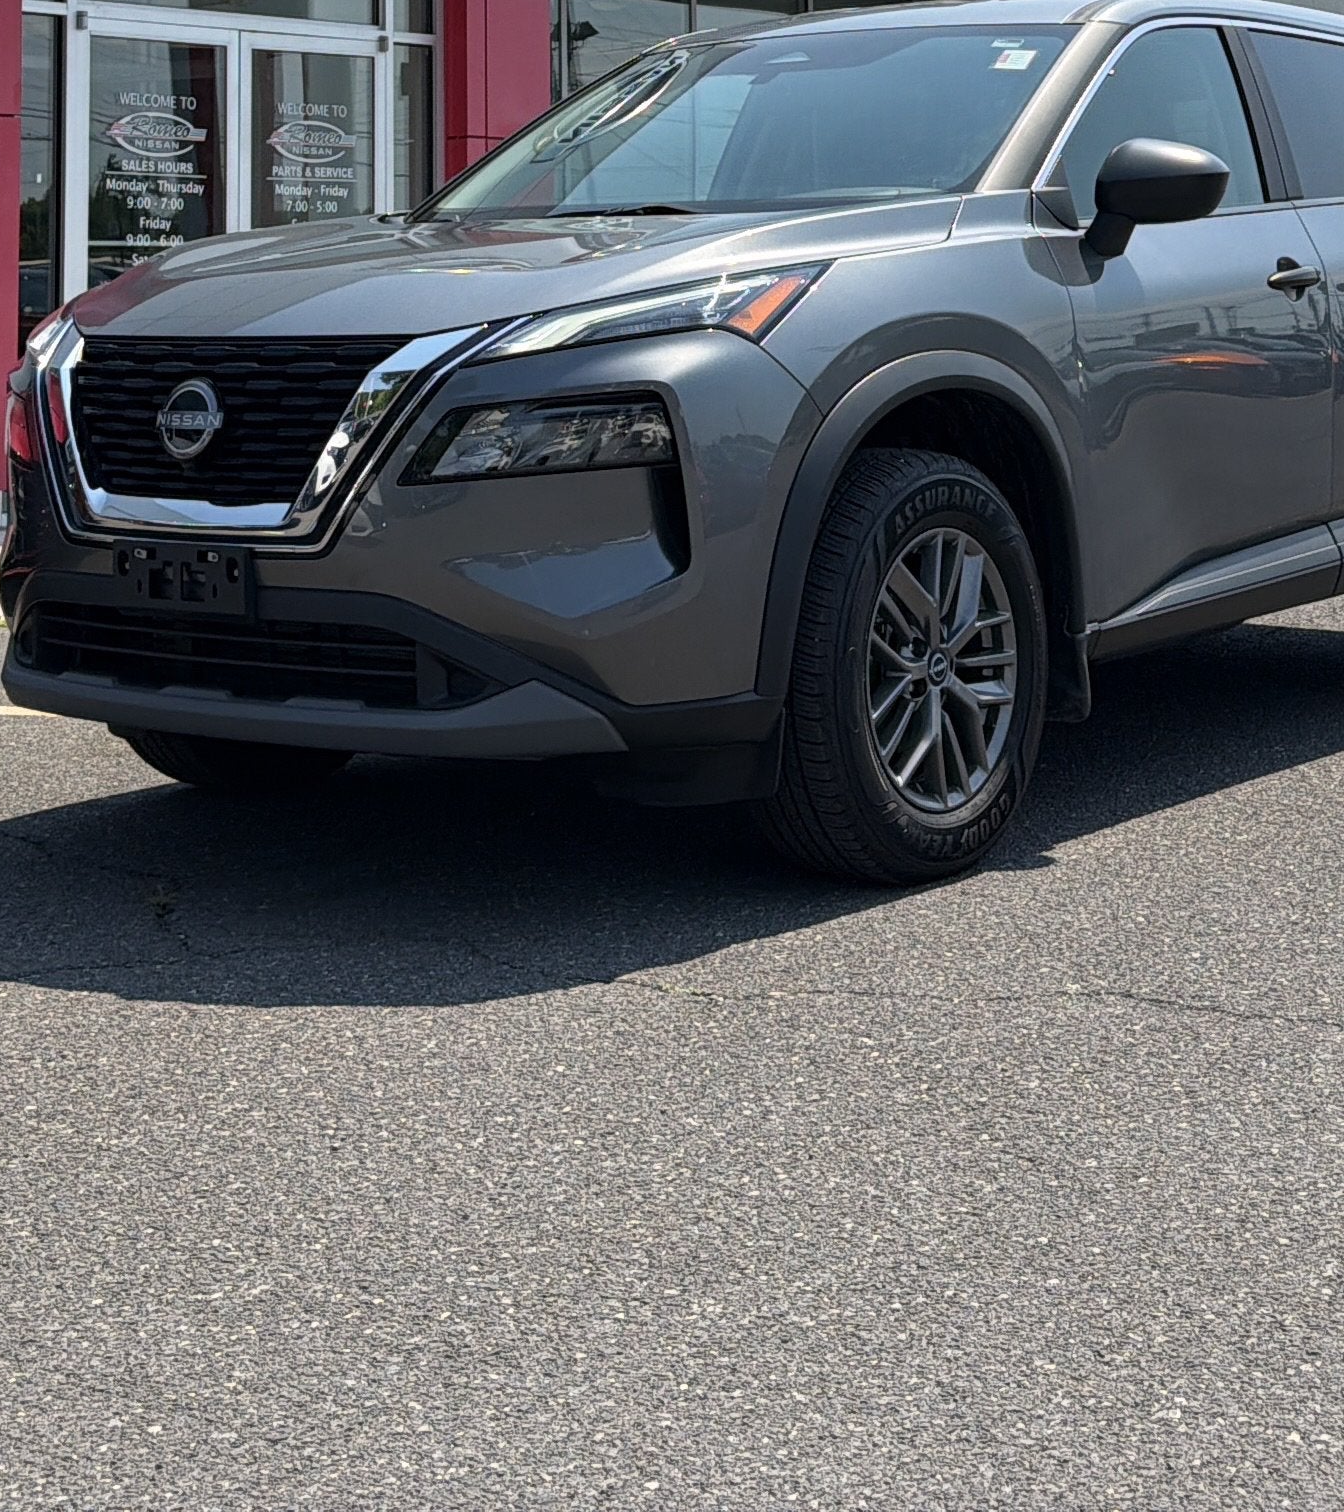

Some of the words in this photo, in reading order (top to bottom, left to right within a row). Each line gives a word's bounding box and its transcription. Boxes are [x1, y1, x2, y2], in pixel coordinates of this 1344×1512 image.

[119, 92, 177, 109] WELCOME
[179, 96, 197, 110] TO
[277, 102, 330, 117] WELCOME
[332, 105, 347, 118] TO
[126, 114, 191, 138] Romeo
[284, 123, 343, 145] Romeo
[134, 139, 180, 149] NISSAN
[292, 146, 333, 156] NISSAN
[121, 159, 156, 172] SALES
[157, 161, 194, 174] HOURS
[272, 166, 303, 177] PARTS
[304, 167, 312, 177] &
[314, 168, 354, 179] SERVICE
[105, 178, 148, 194] Monday
[157, 180, 205, 196] Thursday
[275, 183, 313, 198] Monday
[321, 185, 349, 199] Friday
[126, 196, 152, 209] 9:00
[161, 198, 185, 211] 7:00
[286, 200, 309, 213] 7:00
[316, 201, 338, 213] 5:00
[139, 217, 172, 232] Friday
[126, 234, 151, 246] 9:00
[160, 235, 184, 248] 6:00
[158, 413, 220, 426] NISSAN
[895, 485, 997, 534] ASSURANCE
